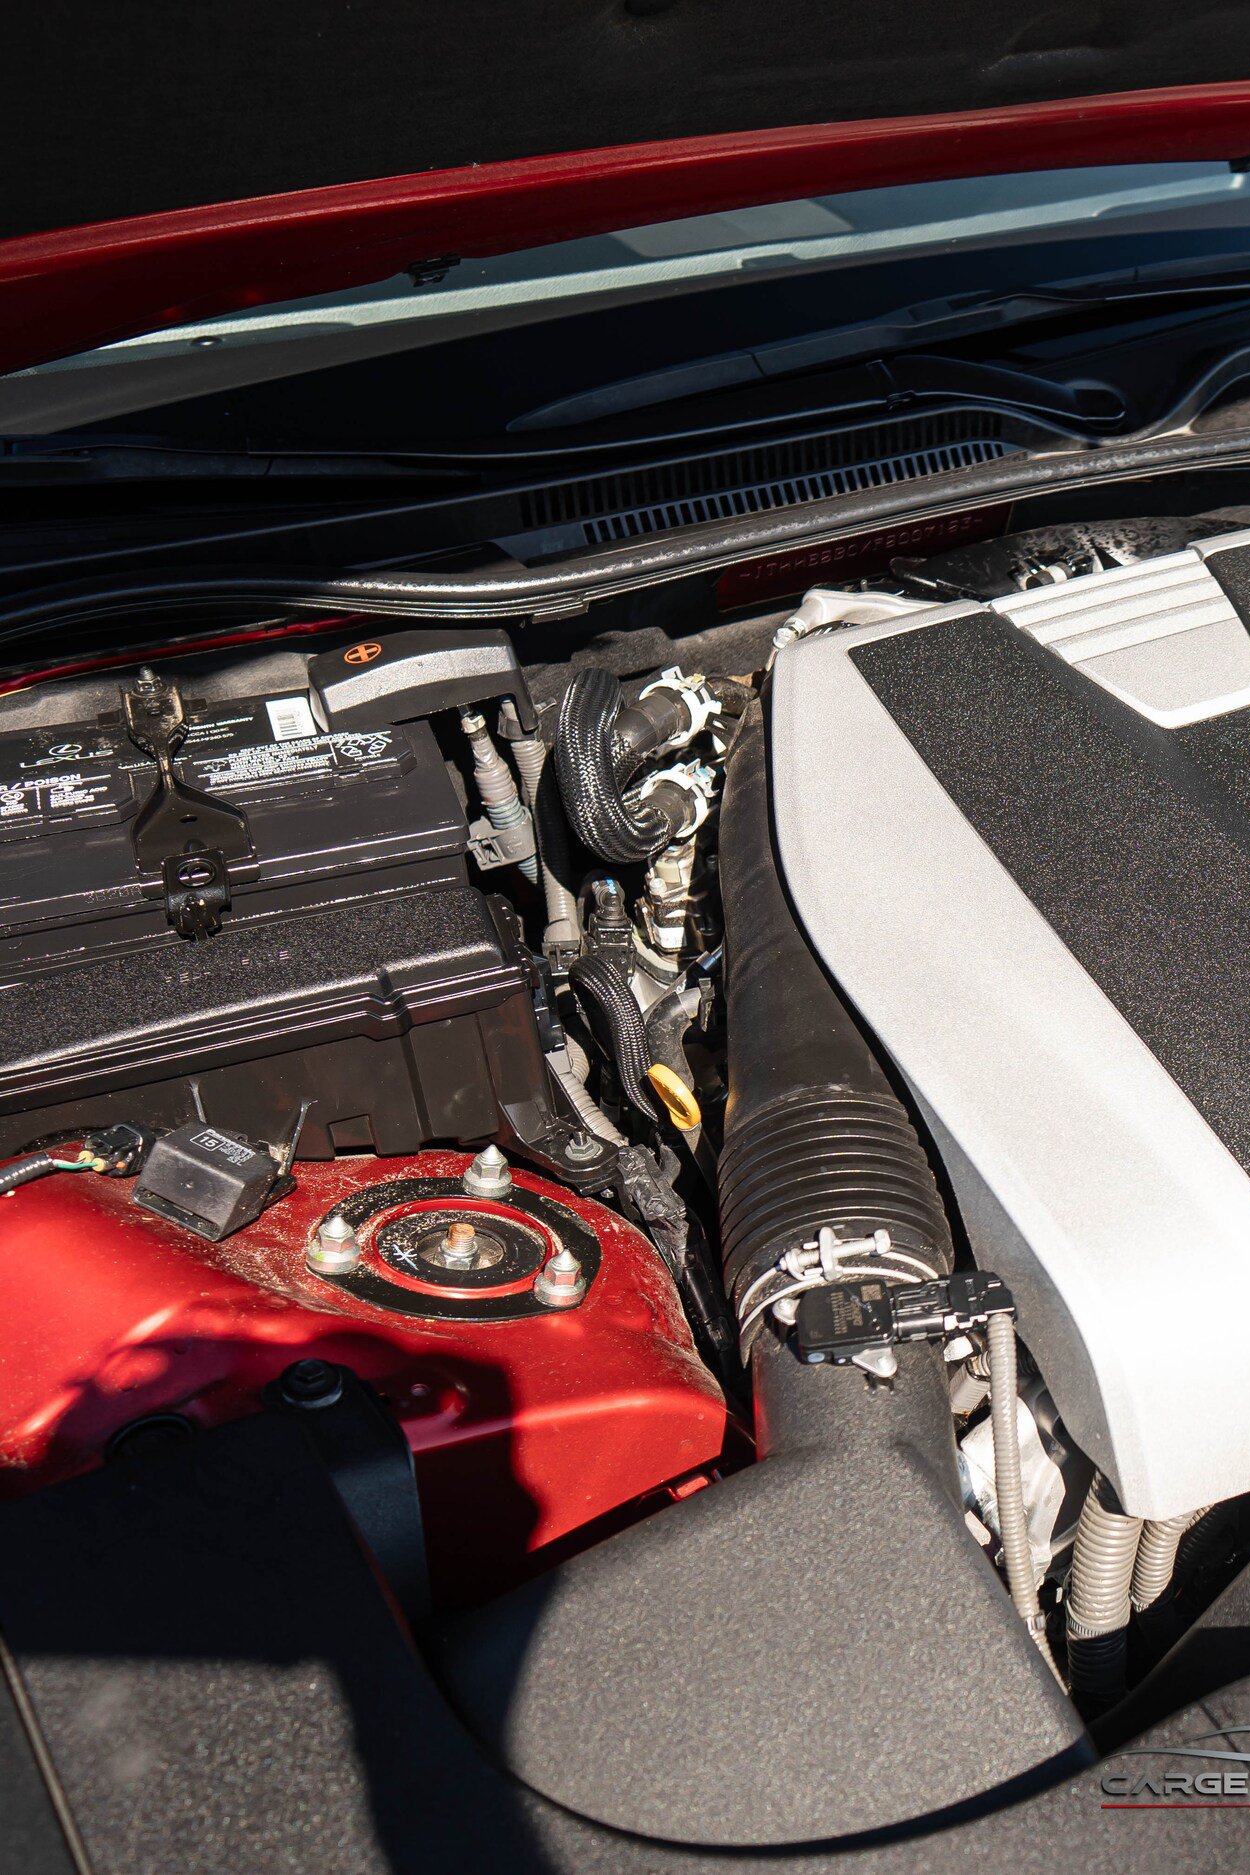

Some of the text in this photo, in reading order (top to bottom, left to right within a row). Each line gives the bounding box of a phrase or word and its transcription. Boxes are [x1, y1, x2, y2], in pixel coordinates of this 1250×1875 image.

[19, 749, 114, 768] LEXUS
[24, 773, 81, 788] POISON
[200, 1136, 219, 1147] 15
